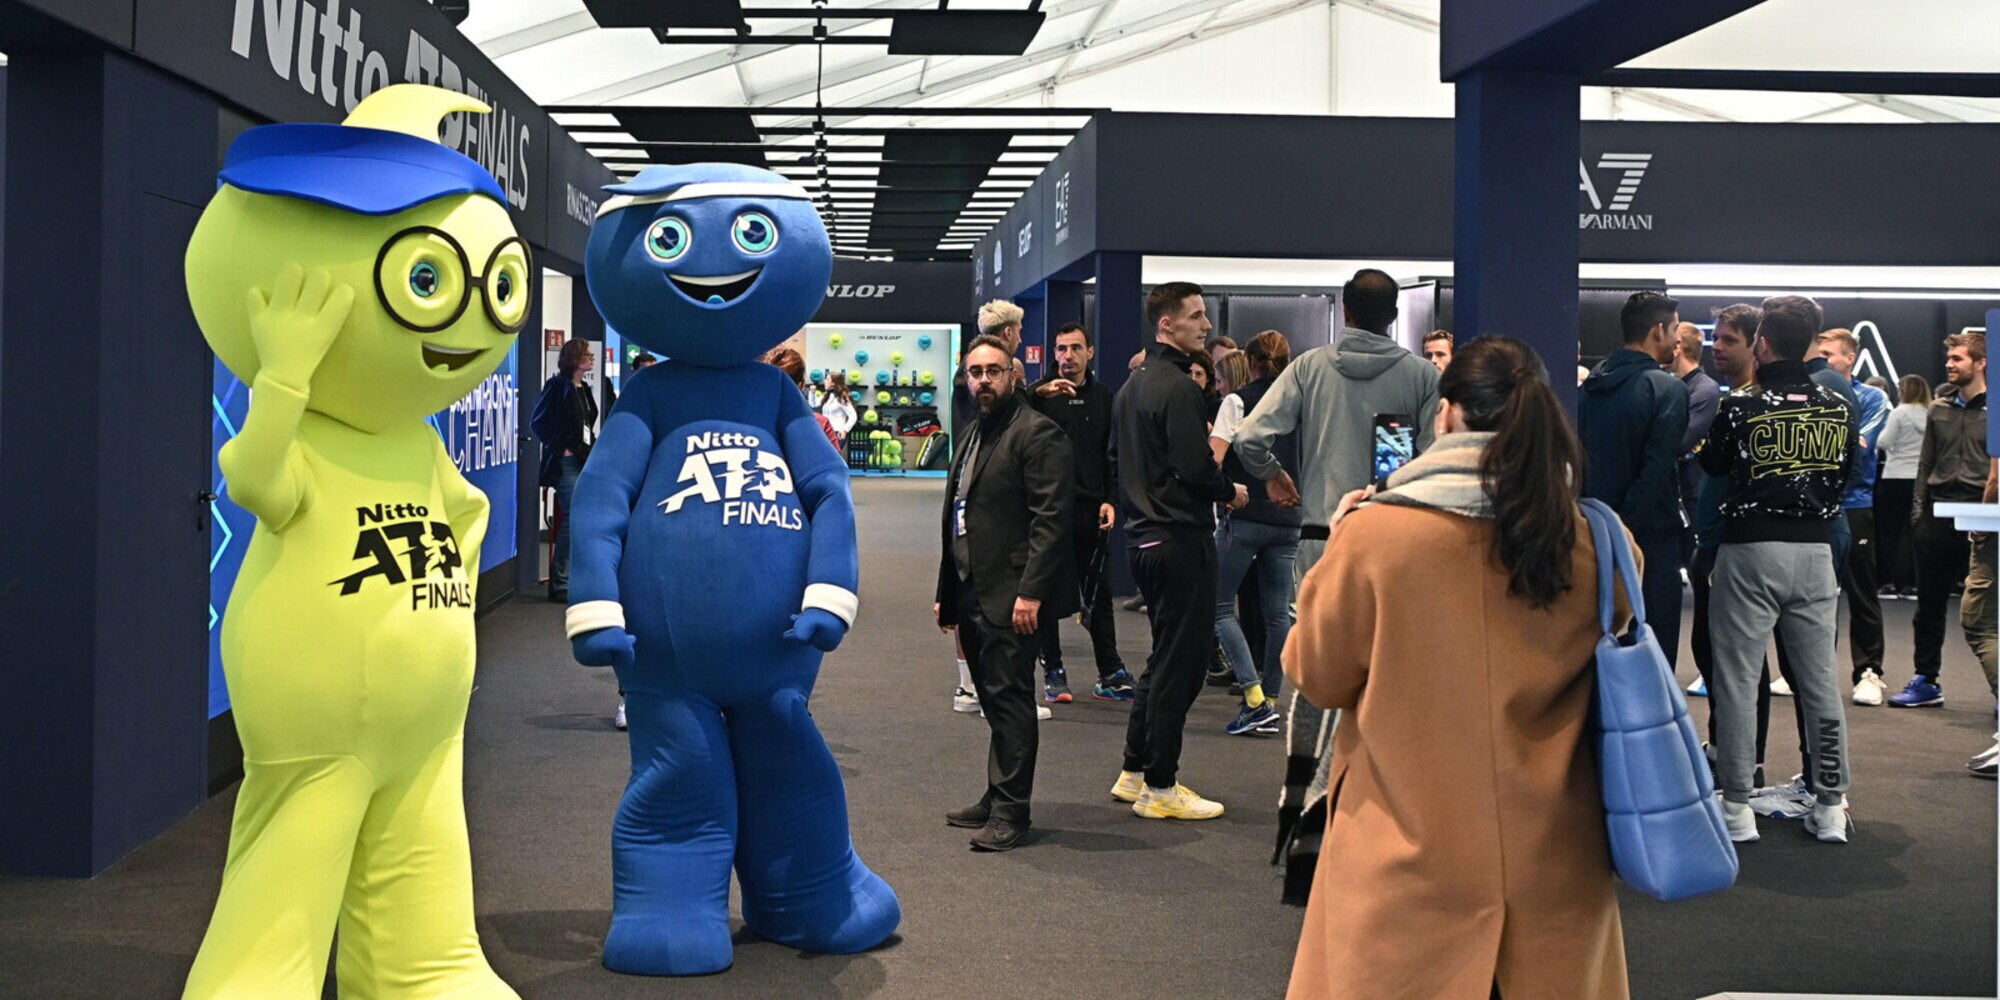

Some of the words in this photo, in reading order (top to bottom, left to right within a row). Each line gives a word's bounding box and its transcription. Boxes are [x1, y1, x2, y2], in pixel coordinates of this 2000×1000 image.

[464, 78, 530, 211] FINALS
[1591, 214, 1653, 230] ARMANI
[825, 284, 896, 298] NLOP
[686, 431, 760, 454] Nitto
[1750, 420, 1849, 464] GUNN
[656, 448, 794, 514] ATP
[356, 503, 429, 527] Nitto
[722, 501, 803, 531] FINALS
[326, 521, 462, 597] ATP
[412, 582, 471, 611] FINALS
[1819, 717, 1841, 788] GUNN
